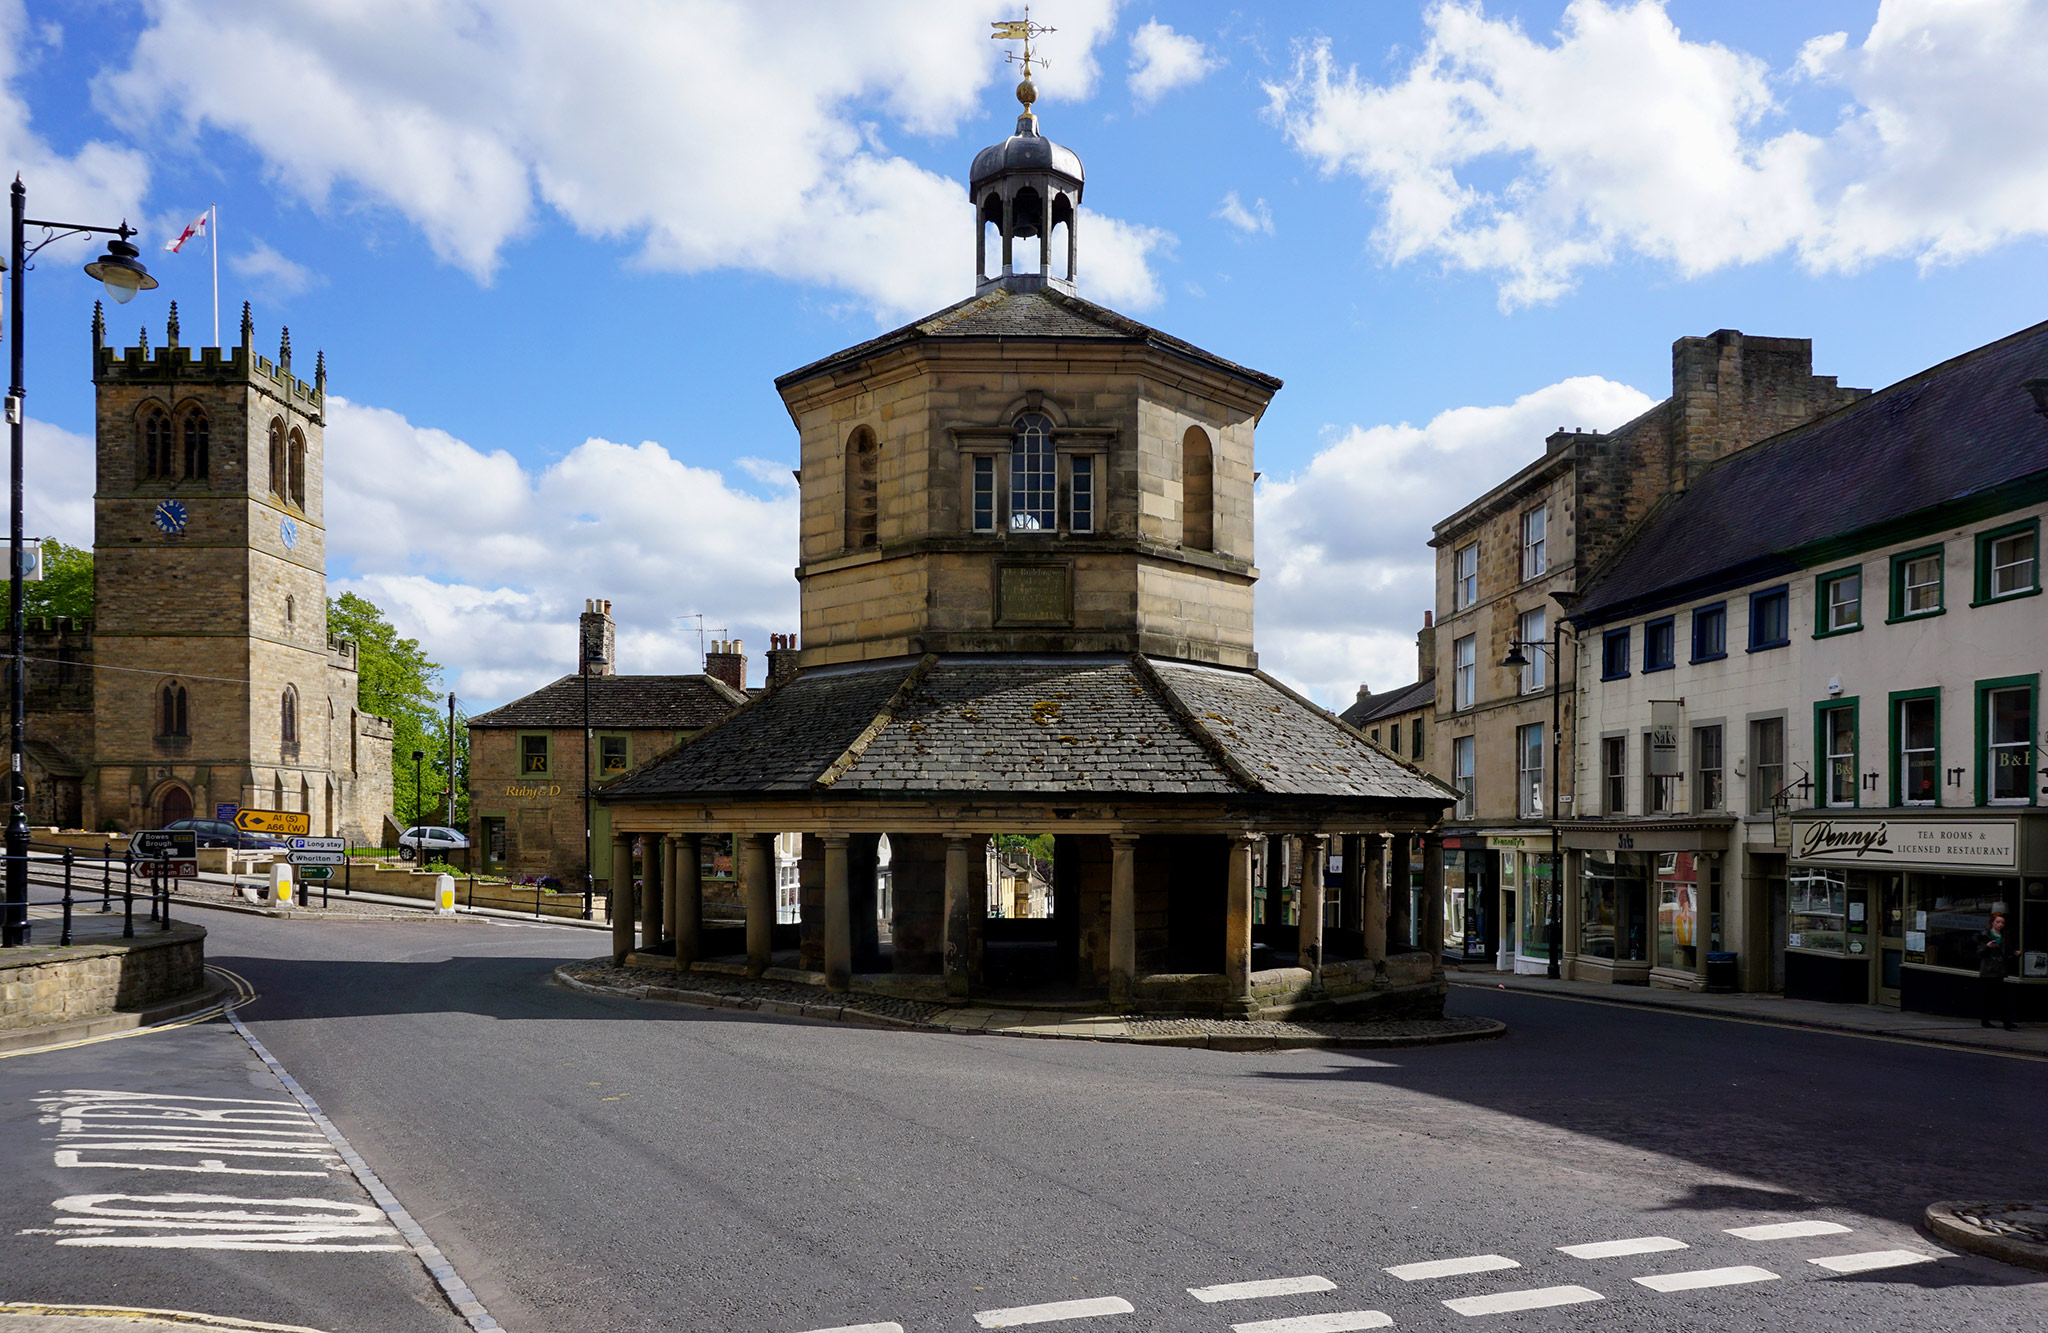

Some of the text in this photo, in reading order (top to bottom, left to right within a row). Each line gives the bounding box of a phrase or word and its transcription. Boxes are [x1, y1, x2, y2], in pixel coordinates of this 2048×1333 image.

[1654, 730, 1676, 744] Saks
[530, 756, 545, 771] R
[608, 757, 626, 771] &
[1999, 752, 2010, 767] B
[2011, 754, 2022, 766] &
[1835, 763, 1842, 775] B
[505, 785, 561, 800] Ruby & D
[285, 814, 299, 823] (S)
[266, 823, 306, 832] A66 (W)
[1800, 820, 1888, 858] Penny's
[1918, 830, 1987, 840] TEA ROOMS &
[307, 840, 324, 848] Long
[326, 841, 342, 849] stay
[1897, 844, 2010, 856] LICENSED RESTAURANT
[296, 854, 331, 862] Whorlton
